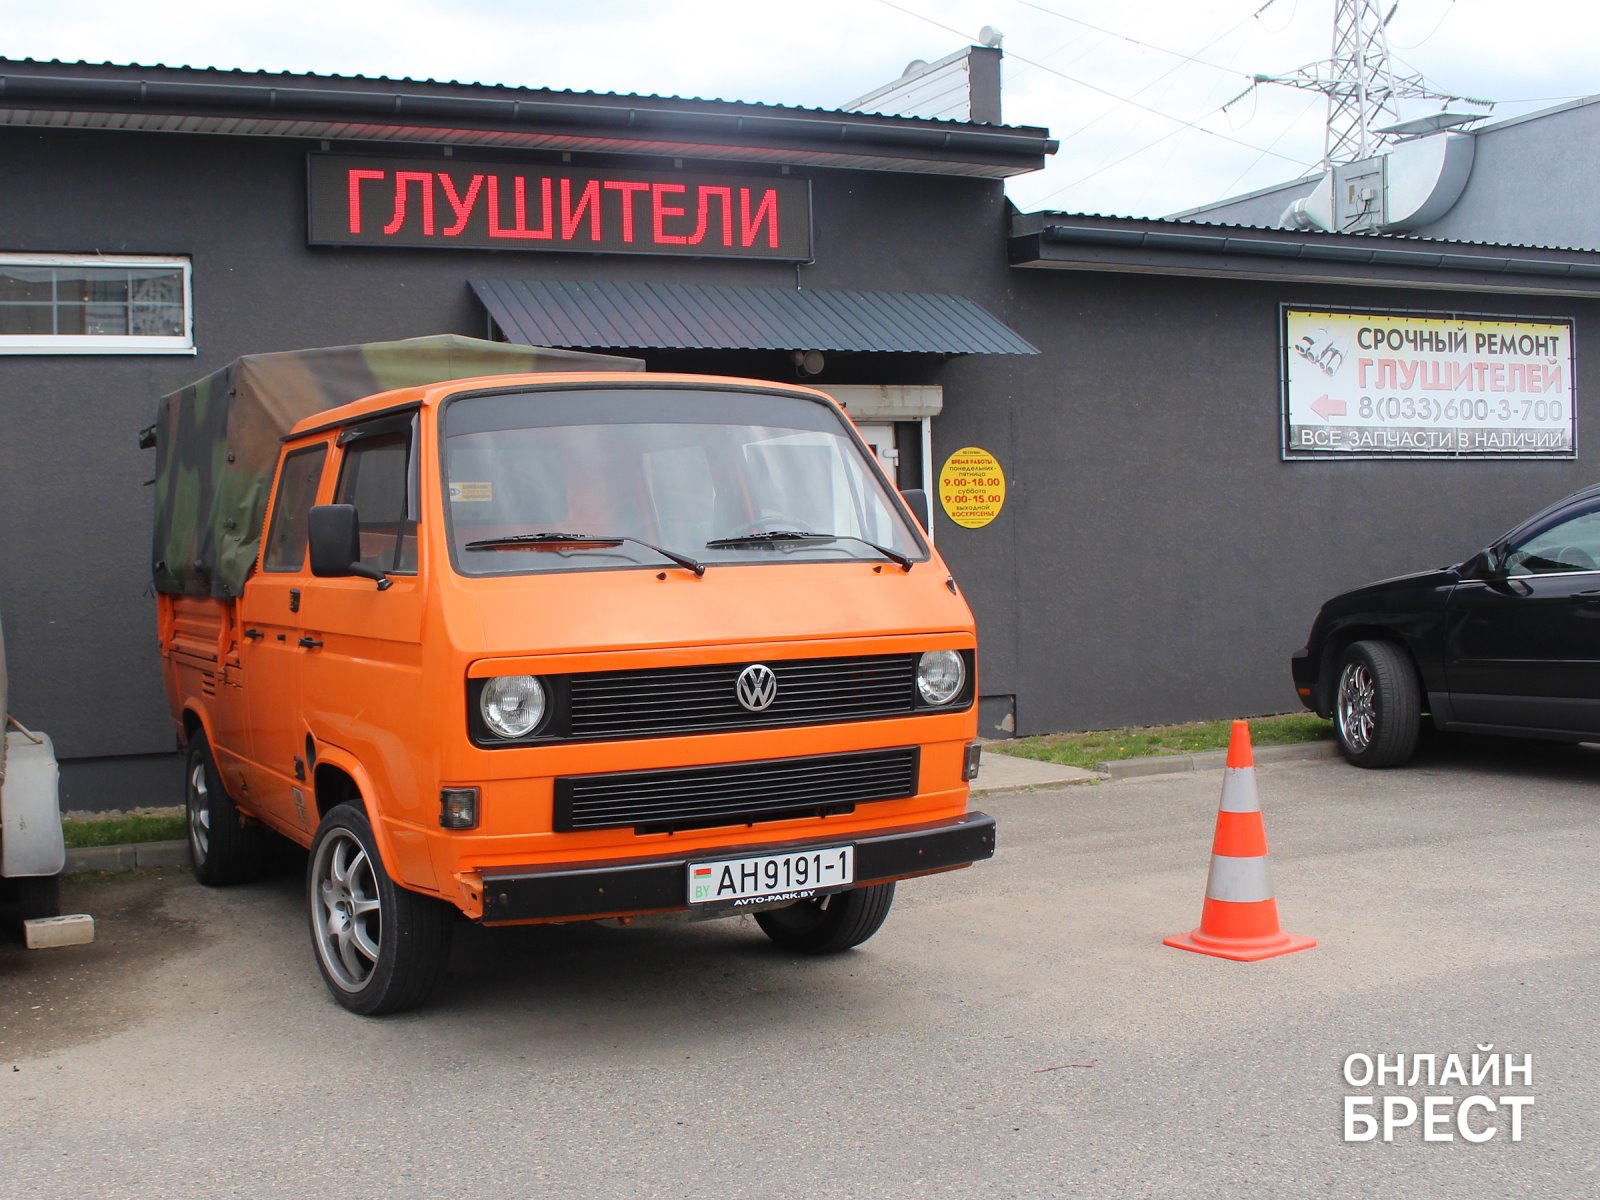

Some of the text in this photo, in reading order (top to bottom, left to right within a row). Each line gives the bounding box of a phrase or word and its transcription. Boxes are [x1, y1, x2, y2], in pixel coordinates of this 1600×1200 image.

[347, 169, 779, 249] ГЛУШИТЕЛИ
[1357, 327, 1560, 357] СРОЧНЫЙ РЕМОНТ
[1357, 358, 1562, 393] ГЛУШИТЕЛЕЙ
[1358, 396, 1563, 422] 8(033)600-3-700
[1301, 430, 1563, 448] ВСЕ ЗАПЧАСТИ В НАЛИЧИИ
[944, 478, 1000, 487] 9.00-18.00
[945, 494, 1001, 503] 9.00-15.00
[695, 885, 709, 898] BY
[734, 889, 816, 906] AVTO-PARK.BY
